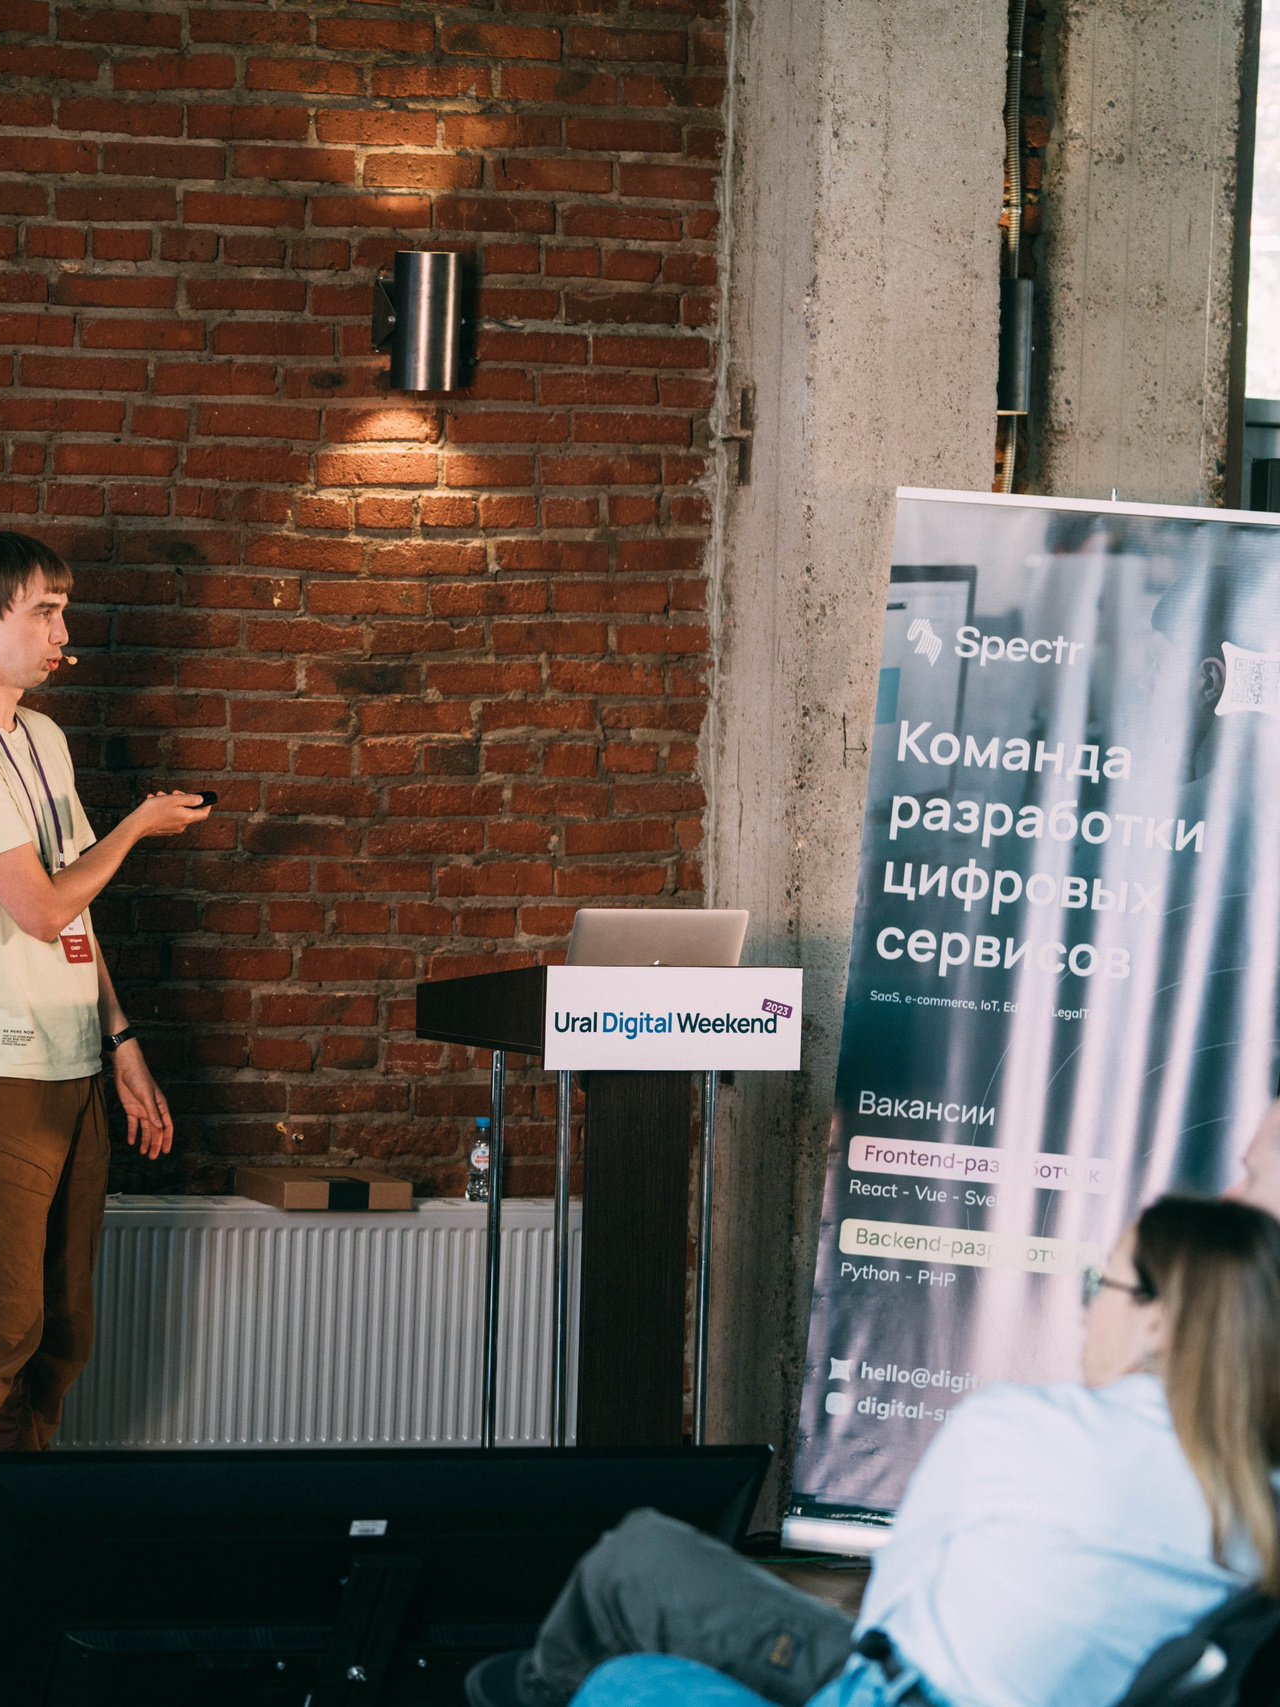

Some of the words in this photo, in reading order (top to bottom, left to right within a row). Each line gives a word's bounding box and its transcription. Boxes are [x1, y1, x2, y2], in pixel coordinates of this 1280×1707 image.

[954, 626, 1085, 667] Spectr
[897, 720, 1132, 784] Команда
[889, 795, 1205, 853] разработки
[883, 858, 1164, 916] цифровых
[876, 926, 1132, 980] сервисов
[764, 1001, 790, 1016] 2023
[870, 990, 902, 1004] SaaS,
[905, 994, 978, 1011] e-commerce,
[980, 999, 1000, 1013] IoT,
[554, 1011, 598, 1033] Ural
[602, 1012, 672, 1040] Digital
[677, 1012, 778, 1034] Weekend
[858, 1090, 995, 1126] Вакансии
[849, 1179, 898, 1198] React
[914, 1185, 947, 1203] Vue
[840, 1262, 900, 1283] Python
[918, 1270, 956, 1287] PHP
[861, 1361, 982, 1393] hello@digit
